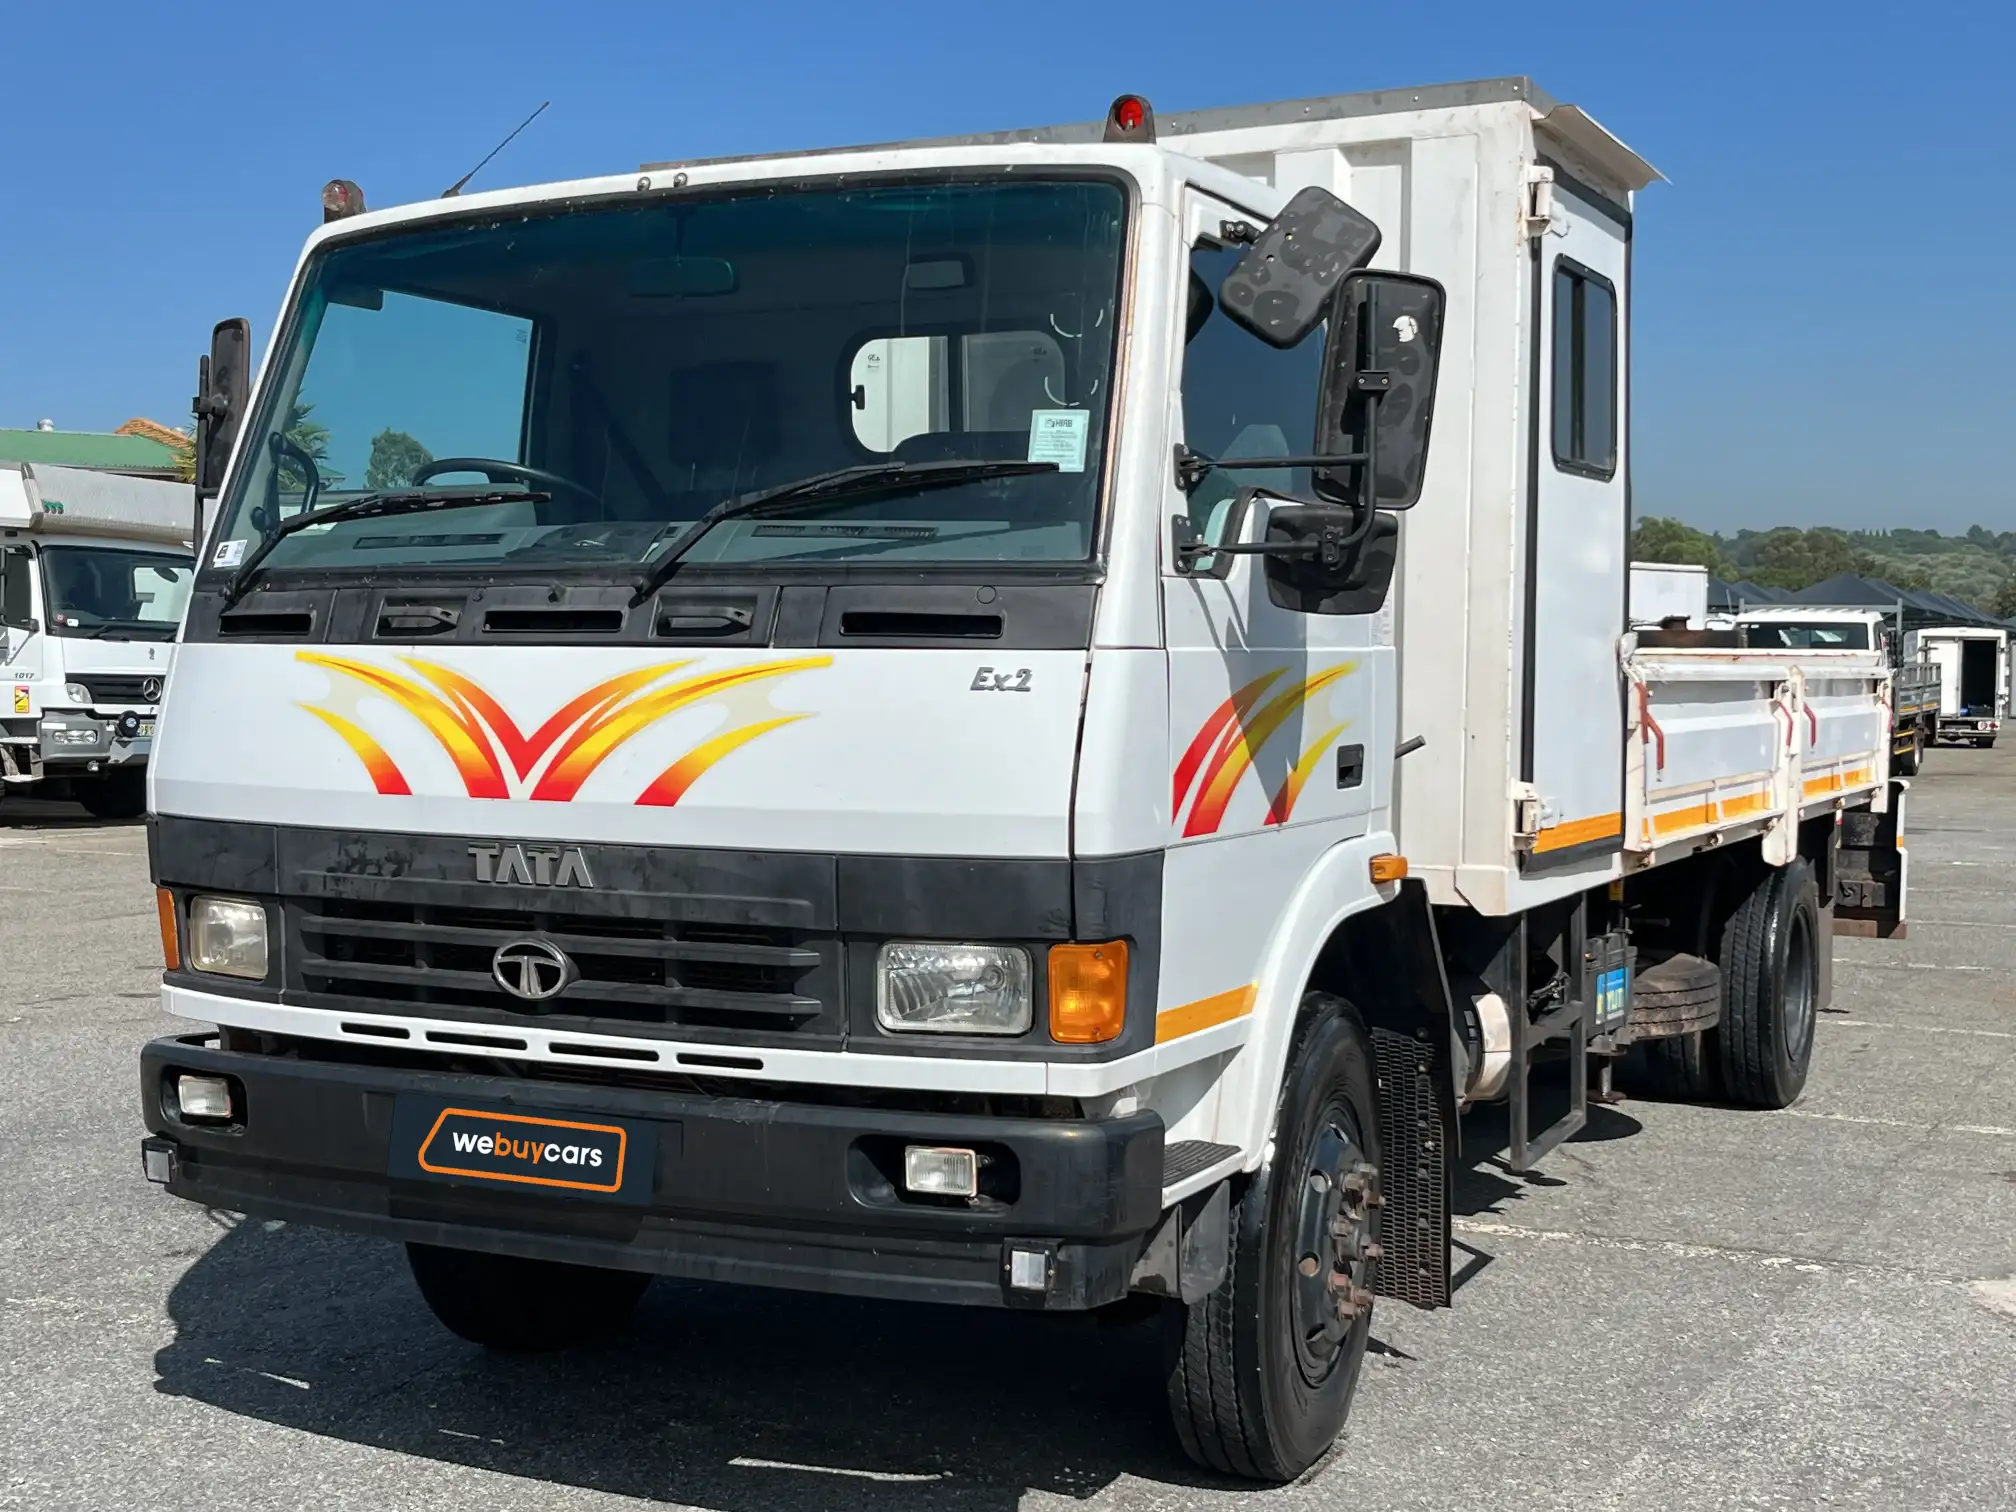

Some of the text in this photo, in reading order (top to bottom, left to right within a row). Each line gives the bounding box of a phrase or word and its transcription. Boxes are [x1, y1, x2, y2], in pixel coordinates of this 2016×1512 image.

[970, 666, 1033, 692] Ex2
[467, 841, 594, 888] TATA
[452, 1131, 603, 1167] webuycars
